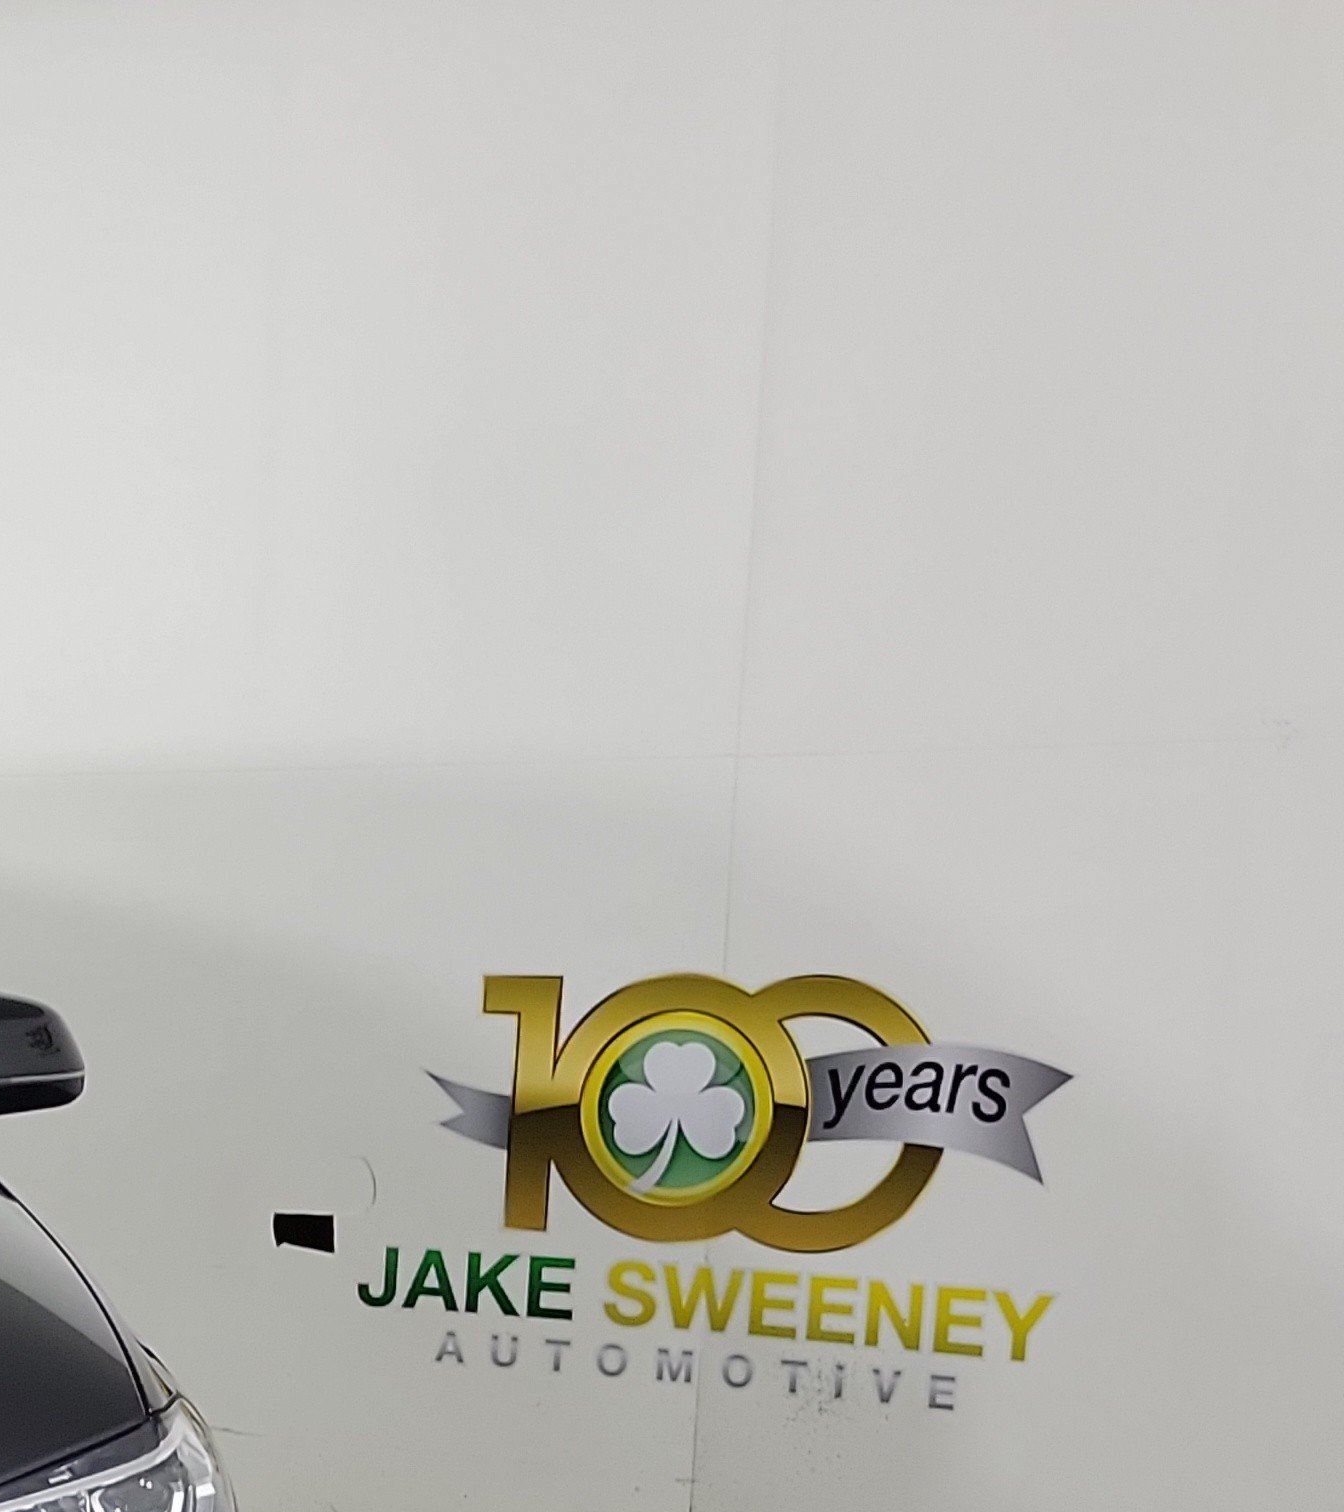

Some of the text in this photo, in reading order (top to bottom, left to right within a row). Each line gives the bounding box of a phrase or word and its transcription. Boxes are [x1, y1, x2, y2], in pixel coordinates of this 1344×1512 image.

[483, 972, 1011, 1254] 100 years
[357, 1246, 1058, 1363] JAKE SWEENEY
[434, 1331, 958, 1411] AUTOMOTIVE
